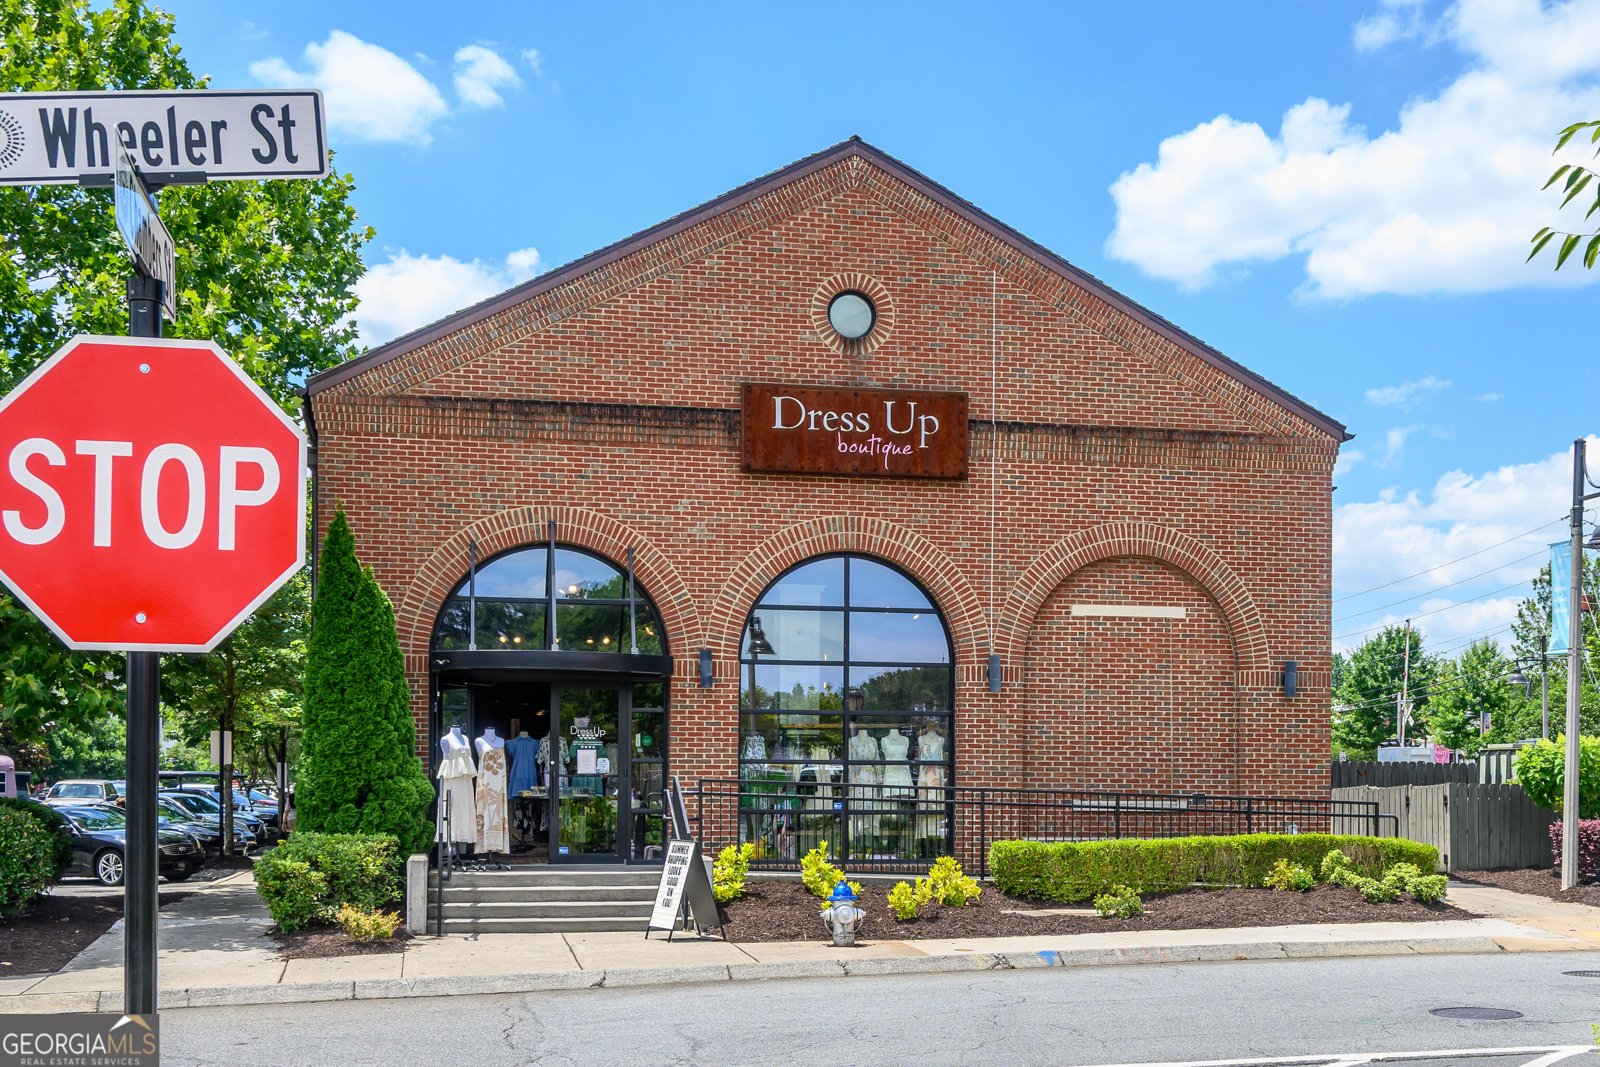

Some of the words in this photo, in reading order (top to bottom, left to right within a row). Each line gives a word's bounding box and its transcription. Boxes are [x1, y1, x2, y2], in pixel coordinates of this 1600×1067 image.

[39, 105, 227, 168] Wheeler
[250, 103, 299, 164] St
[771, 396, 870, 433] Dress
[883, 400, 940, 449] Up
[837, 430, 914, 470] boutique
[2, 437, 281, 551] STOP
[671, 844, 690, 855] SUMMER
[667, 854, 689, 866] SHOPPING
[667, 865, 682, 876] LOOKS
[666, 876, 679, 887] GOOD
[666, 887, 675, 897] ON
